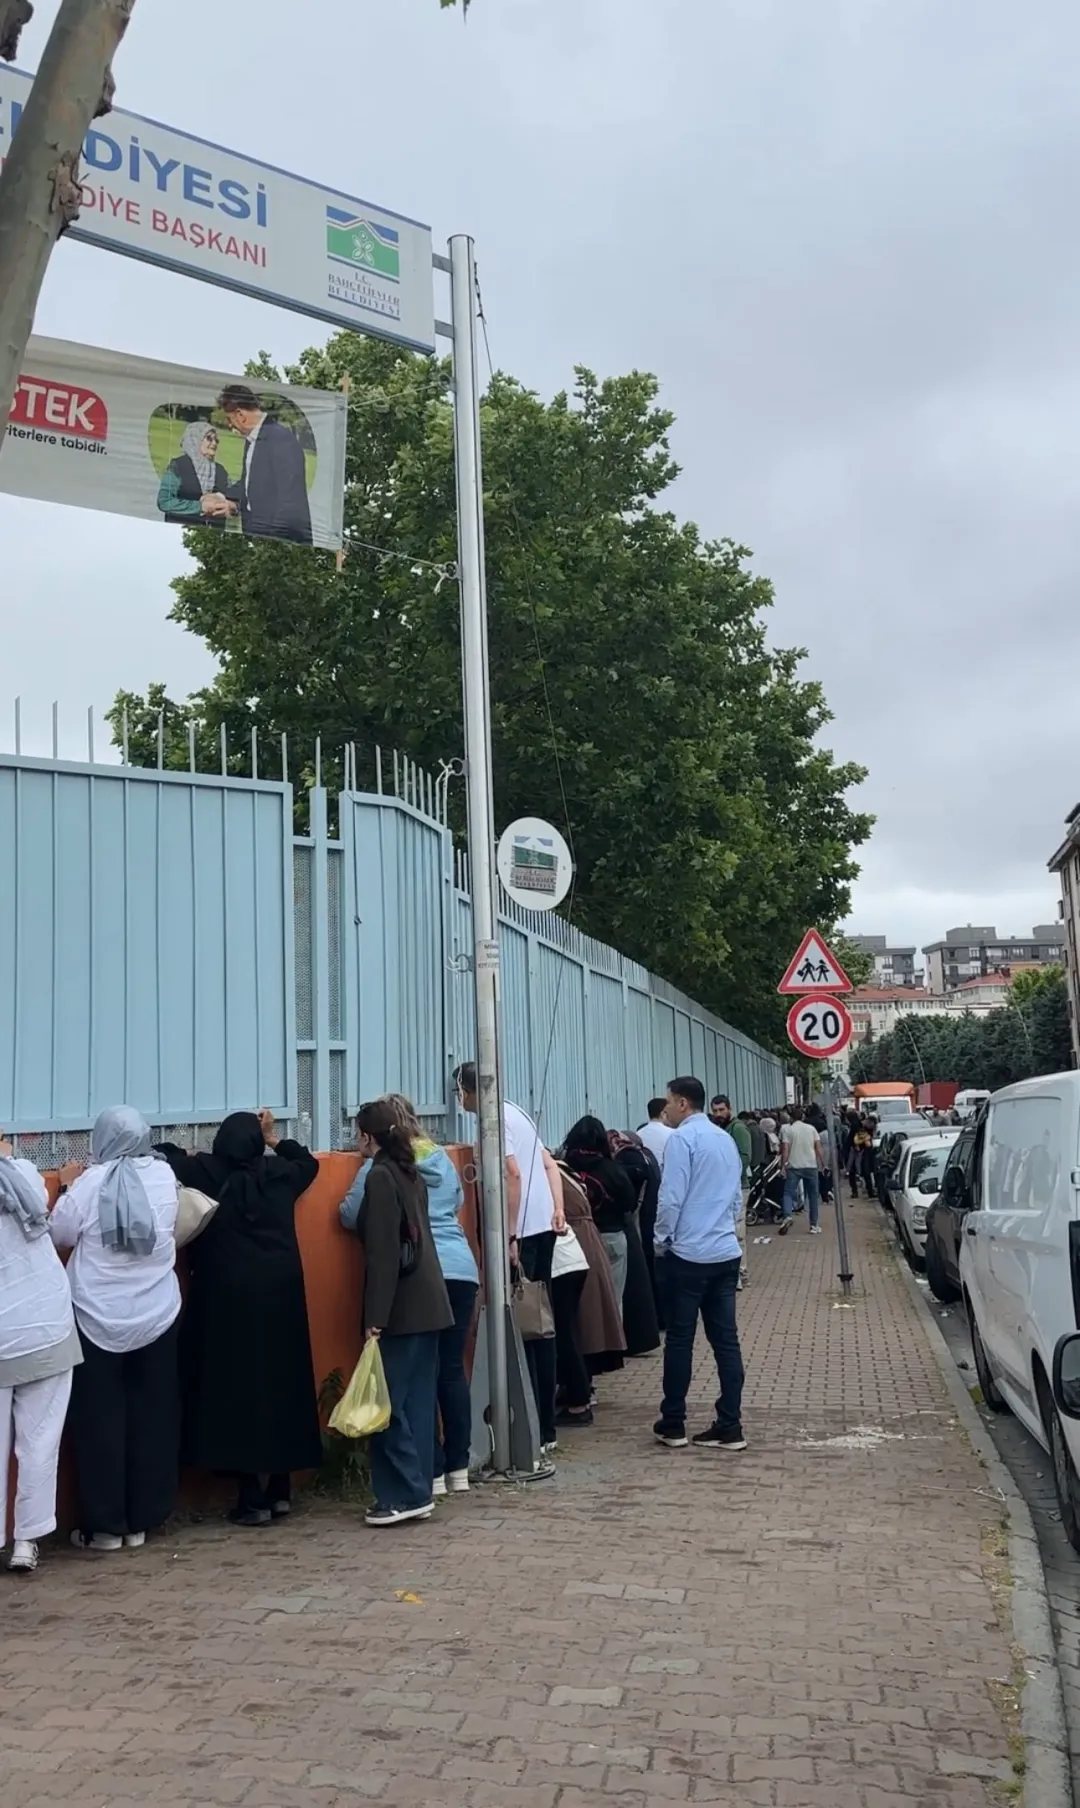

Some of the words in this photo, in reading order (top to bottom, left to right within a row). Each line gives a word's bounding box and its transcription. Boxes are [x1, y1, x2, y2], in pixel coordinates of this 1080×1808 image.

[85, 128, 267, 228] DİYESİ
[78, 184, 141, 226] DİYE
[152, 208, 266, 268] BAŞKANI
[9, 382, 97, 431] TEK
[6, 425, 57, 445] iterlere
[61, 436, 108, 456] tabidir.
[801, 1010, 840, 1041] 20
